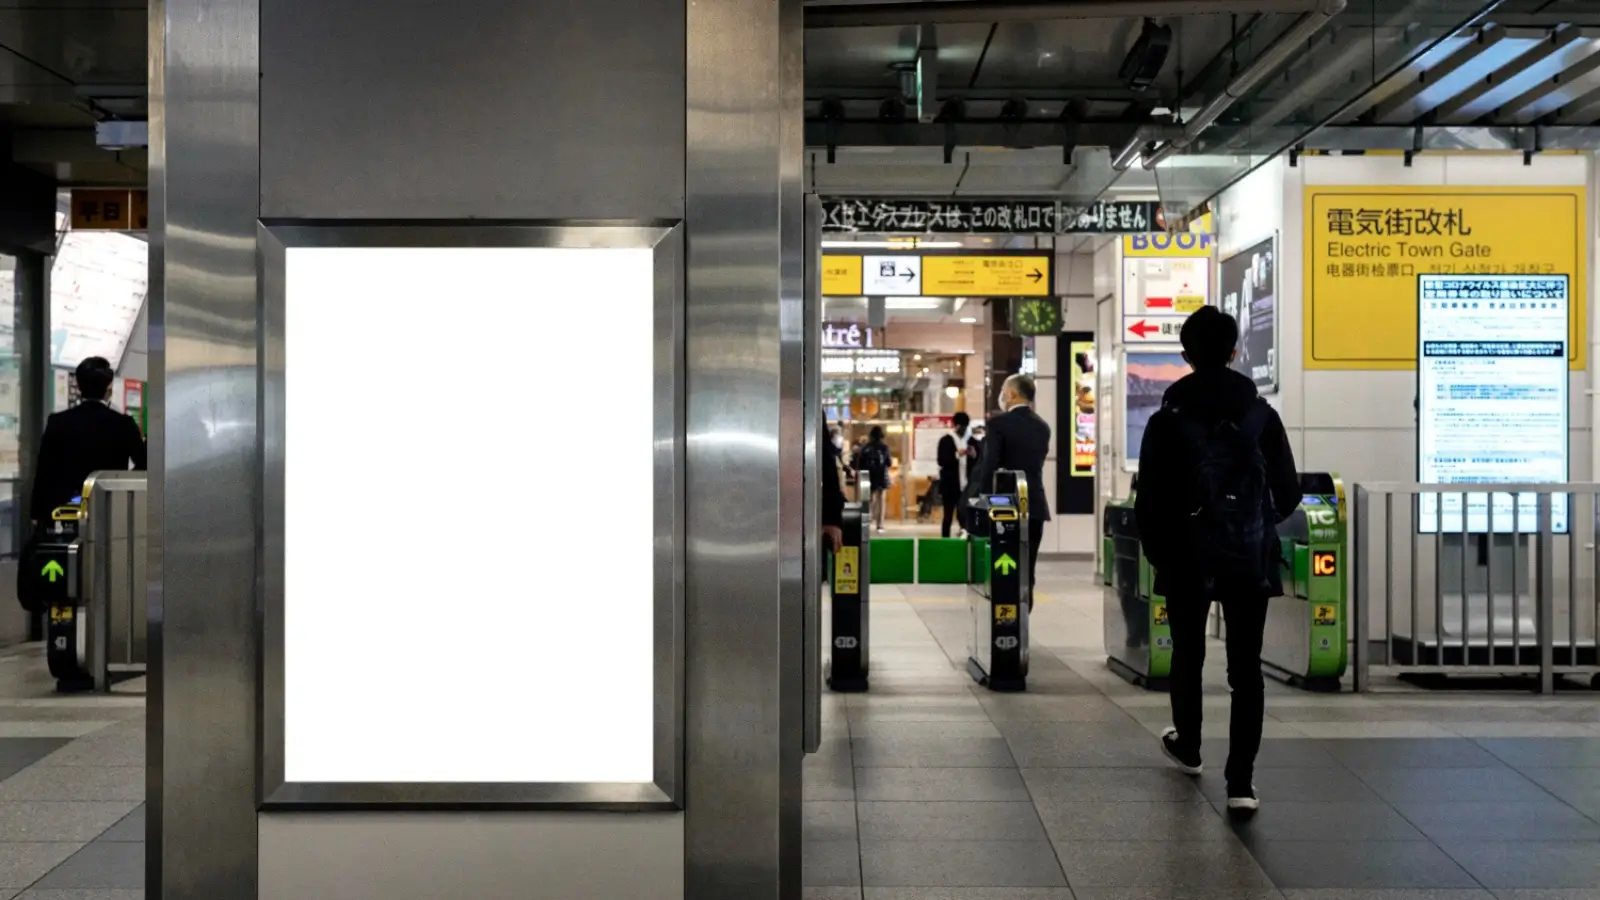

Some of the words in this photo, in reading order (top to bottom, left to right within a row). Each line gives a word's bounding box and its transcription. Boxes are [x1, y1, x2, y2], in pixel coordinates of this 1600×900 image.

[1327, 208, 1472, 236] 電気街改札
[1327, 241, 1391, 258] Electric
[1397, 242, 1443, 258] Town
[1450, 242, 1491, 258] Gate
[1307, 510, 1336, 525] IC
[1315, 554, 1336, 575] IC
